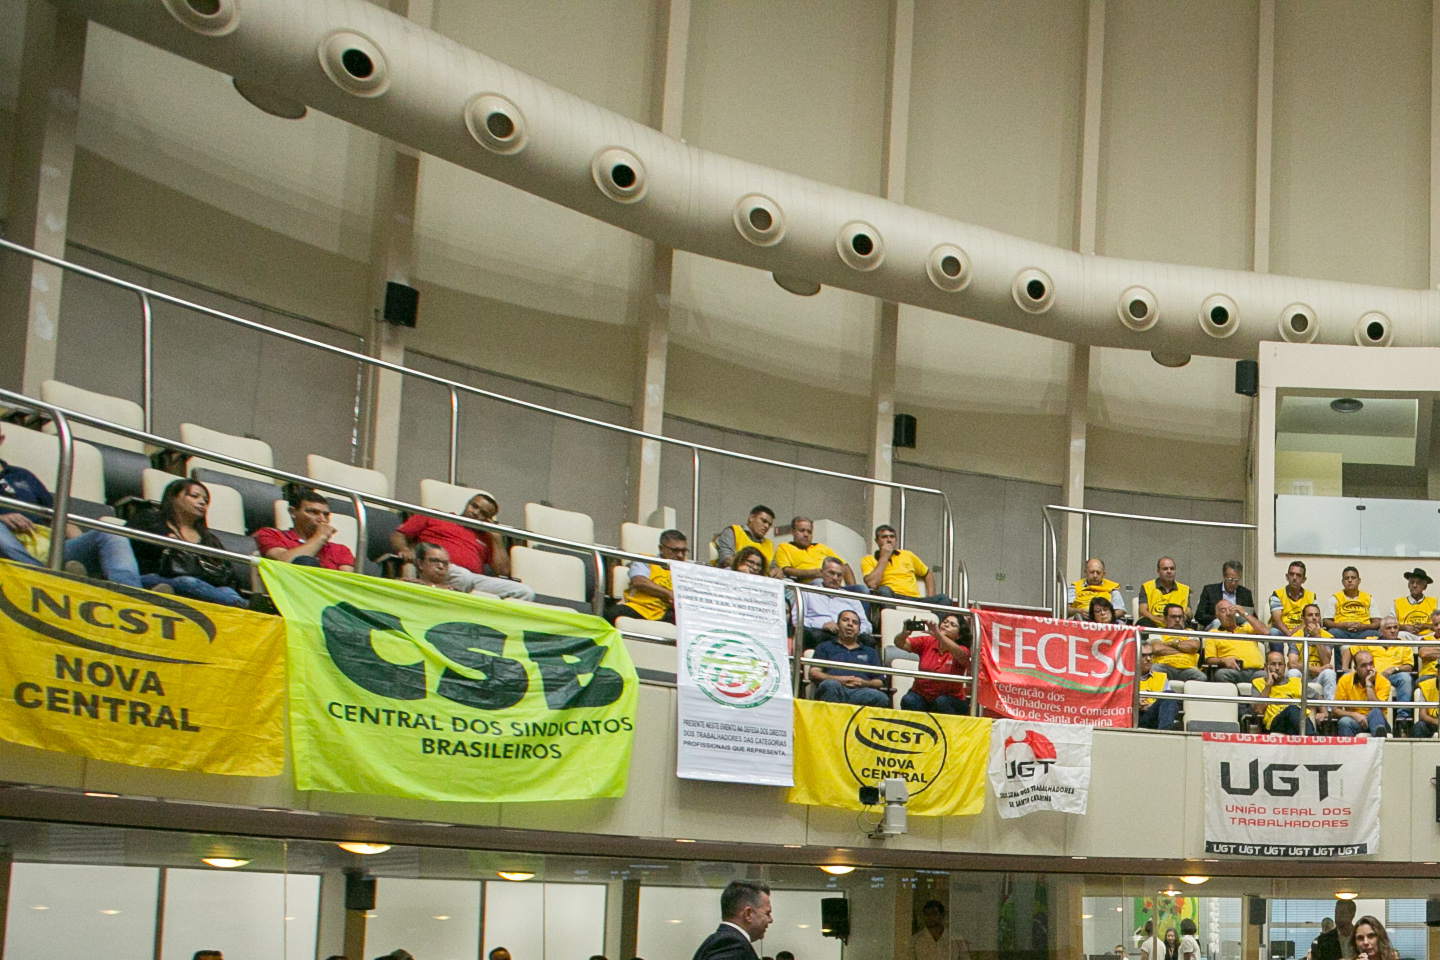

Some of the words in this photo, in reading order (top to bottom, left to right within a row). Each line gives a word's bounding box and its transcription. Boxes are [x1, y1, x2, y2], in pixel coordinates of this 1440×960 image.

[30, 586, 185, 641] NCST
[321, 601, 625, 711] CSB
[55, 654, 165, 696] NOVA
[1047, 691, 1066, 702] dos
[13, 682, 200, 733] CENTRAL
[1064, 705, 1078, 714] no
[1080, 705, 1125, 716] Comércio
[328, 701, 444, 732] CENTRAL
[452, 717, 503, 736] DOS
[510, 716, 634, 738] SINDICATOS
[1028, 710, 1041, 720] de
[1043, 713, 1071, 724] Santa
[1073, 716, 1113, 727] Catarina
[683, 730, 695, 738] DOS
[696, 731, 743, 743] TRABALHADORES
[755, 737, 787, 747] CATEGORIAS
[870, 727, 925, 745] NCST
[1211, 732, 1232, 741] UGT
[1236, 733, 1258, 742] UGT
[1262, 734, 1284, 743] UGT
[1287, 735, 1309, 744] UGT
[421, 738, 562, 760] BRASILEIROS
[683, 740, 731, 751] PROFISSIONAIS
[732, 745, 746, 753] QUE
[876, 756, 915, 770] NOVA
[1005, 759, 1056, 780] UGT
[861, 767, 928, 784] CENTRAL
[1220, 758, 1344, 802] UGT
[1031, 784, 1075, 795] TRABALHADORES
[1225, 803, 1267, 815] UNIÃO
[1272, 807, 1316, 816] GERAL
[1322, 807, 1351, 816] DOS
[1229, 816, 1349, 828] TRABALHADORES
[1213, 843, 1236, 853] UGT
[1238, 844, 1261, 854] UGT
[1263, 845, 1286, 855] UGT
[1288, 846, 1311, 856] UGT
[1313, 846, 1335, 856] UGT
[1337, 845, 1360, 855] UGT
